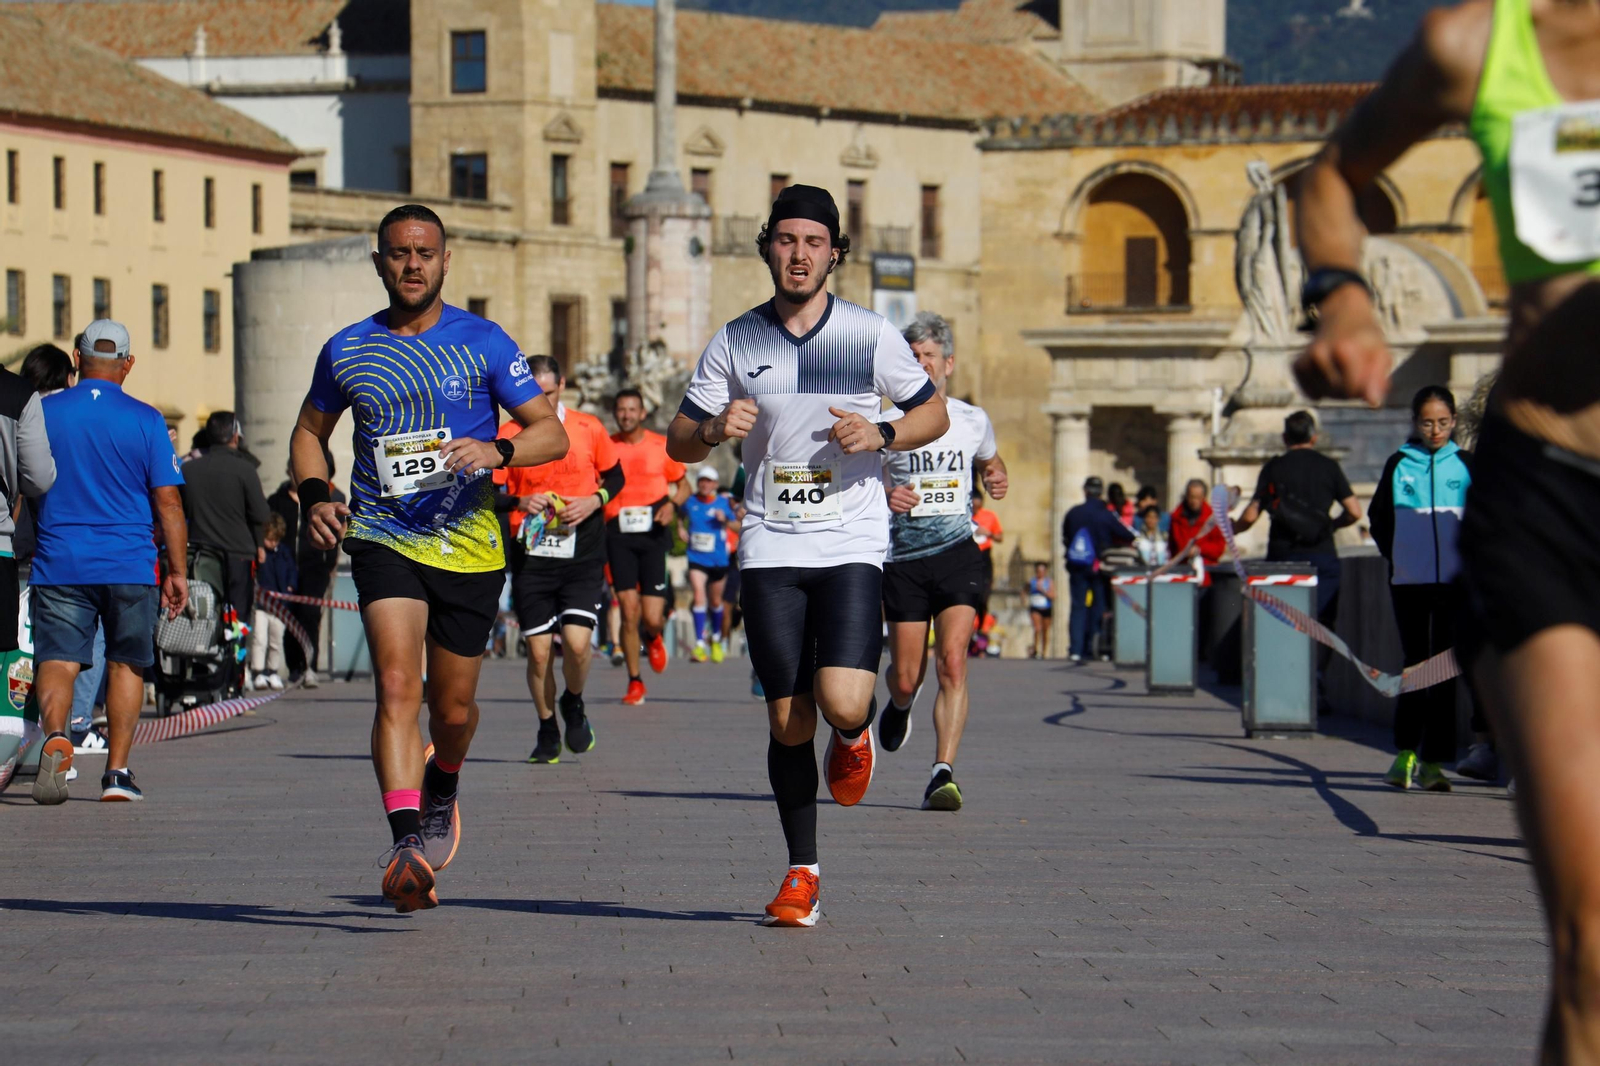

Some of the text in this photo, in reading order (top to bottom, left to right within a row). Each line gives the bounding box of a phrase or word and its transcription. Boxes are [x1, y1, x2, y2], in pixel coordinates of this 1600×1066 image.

[392, 457, 436, 478] 129
[777, 488, 825, 505] 440
[923, 491, 955, 504] 283
[539, 537, 561, 548] 211
